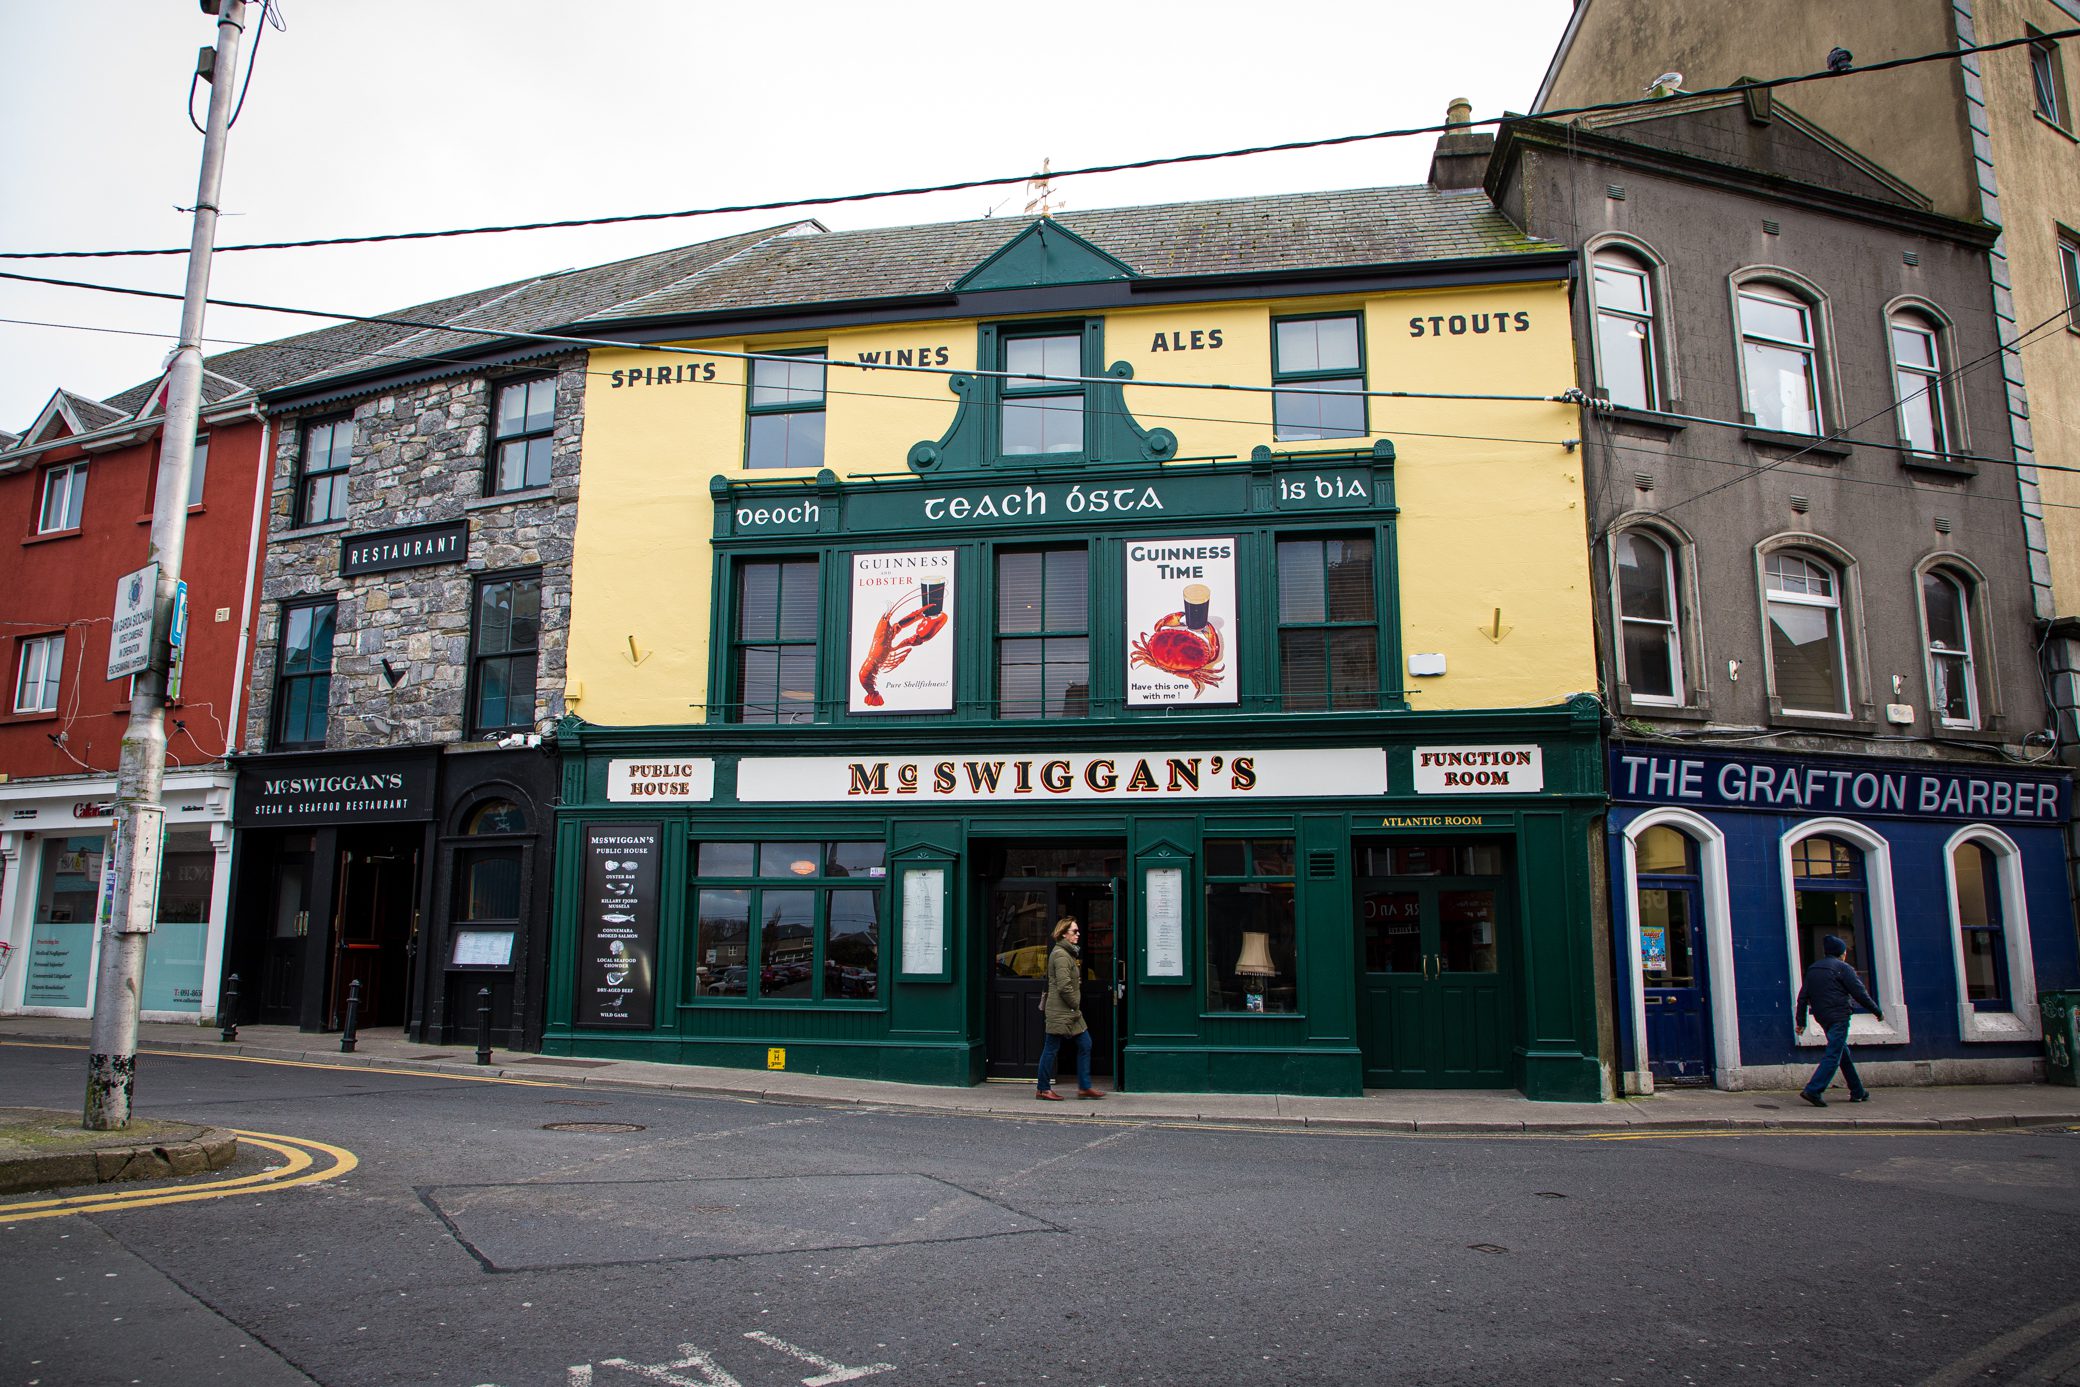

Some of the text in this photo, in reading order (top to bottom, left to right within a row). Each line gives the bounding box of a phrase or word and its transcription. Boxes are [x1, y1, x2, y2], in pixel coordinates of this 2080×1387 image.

[1409, 311, 1530, 338] STOUTS
[1151, 329, 1224, 353] ALES
[858, 346, 950, 372] WINES
[611, 362, 717, 389] SPIRITS
[351, 535, 457, 565] RESTAURANT
[859, 555, 949, 570] GUINNESS
[1157, 565, 1204, 579] TIME
[859, 576, 914, 587] LOBSTER
[885, 680, 949, 690] Pure Shellfishness!
[1131, 682, 1189, 691] Have this one
[1142, 691, 1161, 700] with
[1420, 751, 1531, 767] FUNCTION
[628, 764, 693, 778] PUBLIC
[1444, 771, 1510, 787] ROOM
[1621, 755, 2060, 818] THE GRAFTON BARBER
[630, 781, 690, 796] HOUSE
[255, 799, 408, 815] STEAK & SEAFOOD RESTAURANT
[1382, 816, 1482, 827] ATLANTIC ROOM
